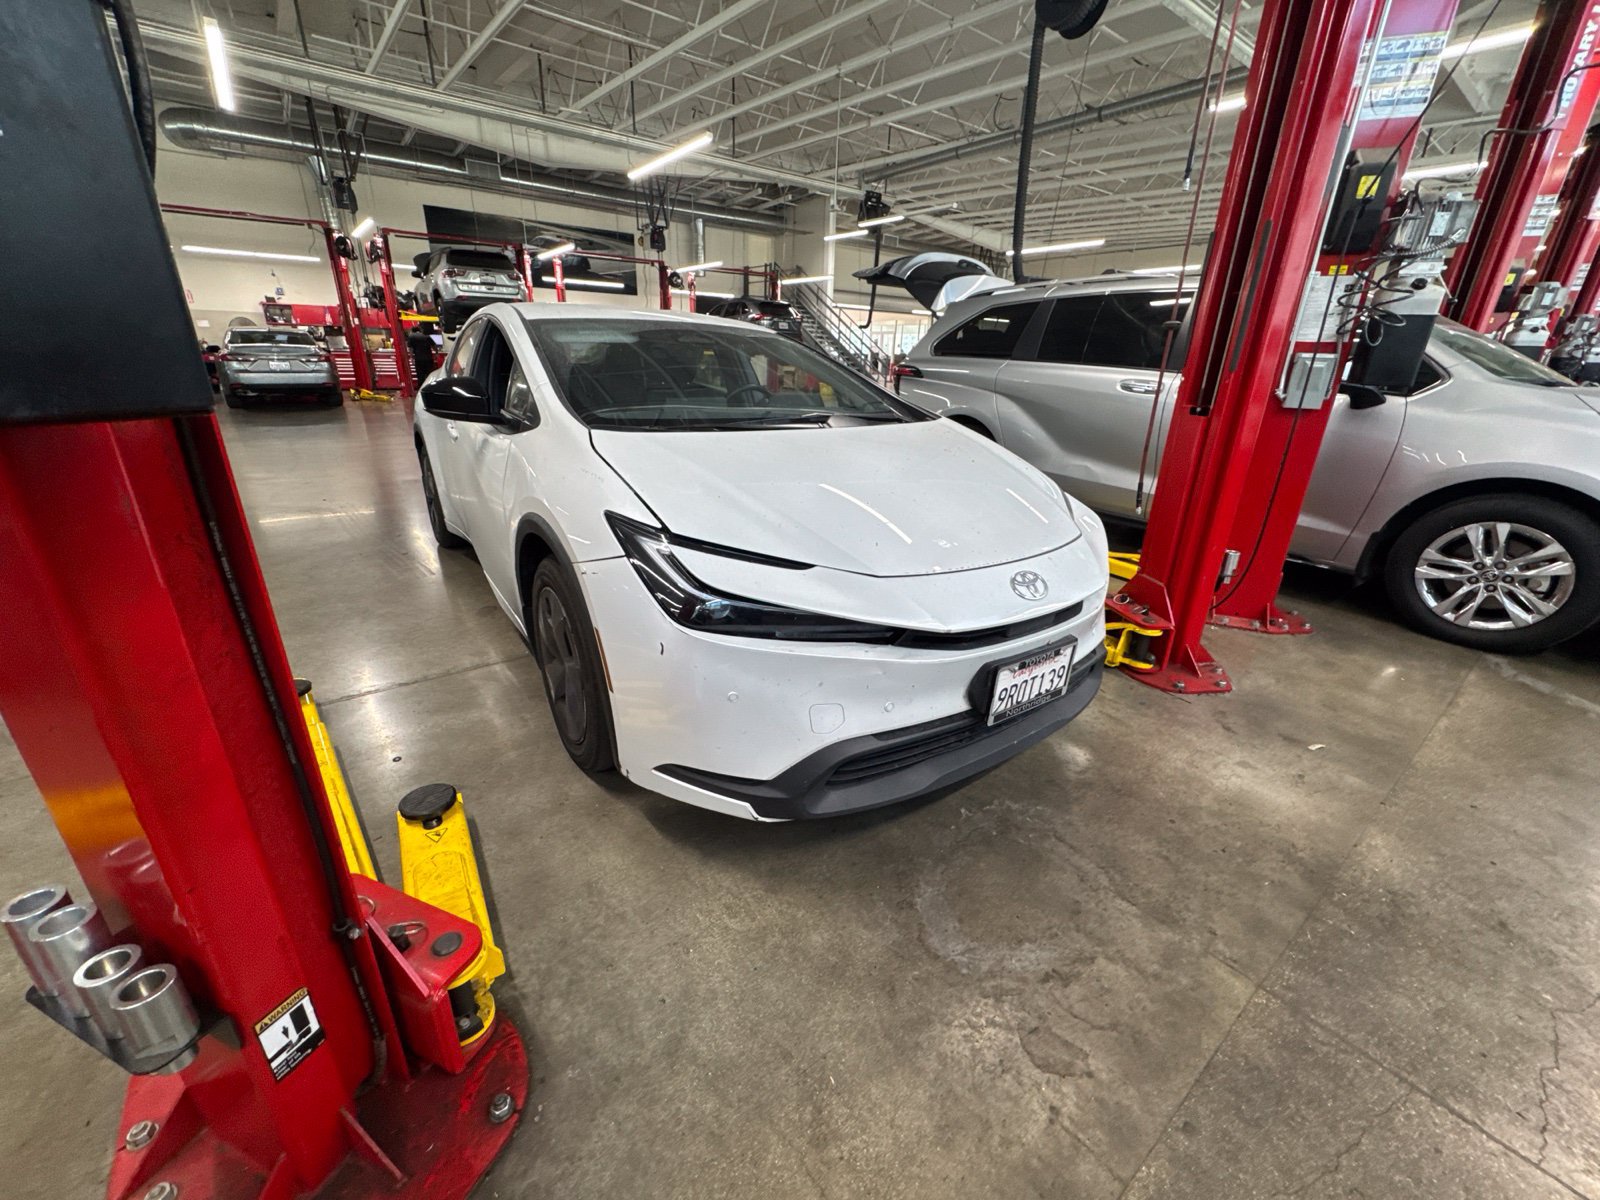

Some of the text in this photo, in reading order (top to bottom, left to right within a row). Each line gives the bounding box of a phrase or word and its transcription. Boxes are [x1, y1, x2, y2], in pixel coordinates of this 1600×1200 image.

[1025, 650, 1055, 667] TOYOTA
[1005, 694, 1052, 717] Northridge
[267, 989, 306, 1022] WARNING
